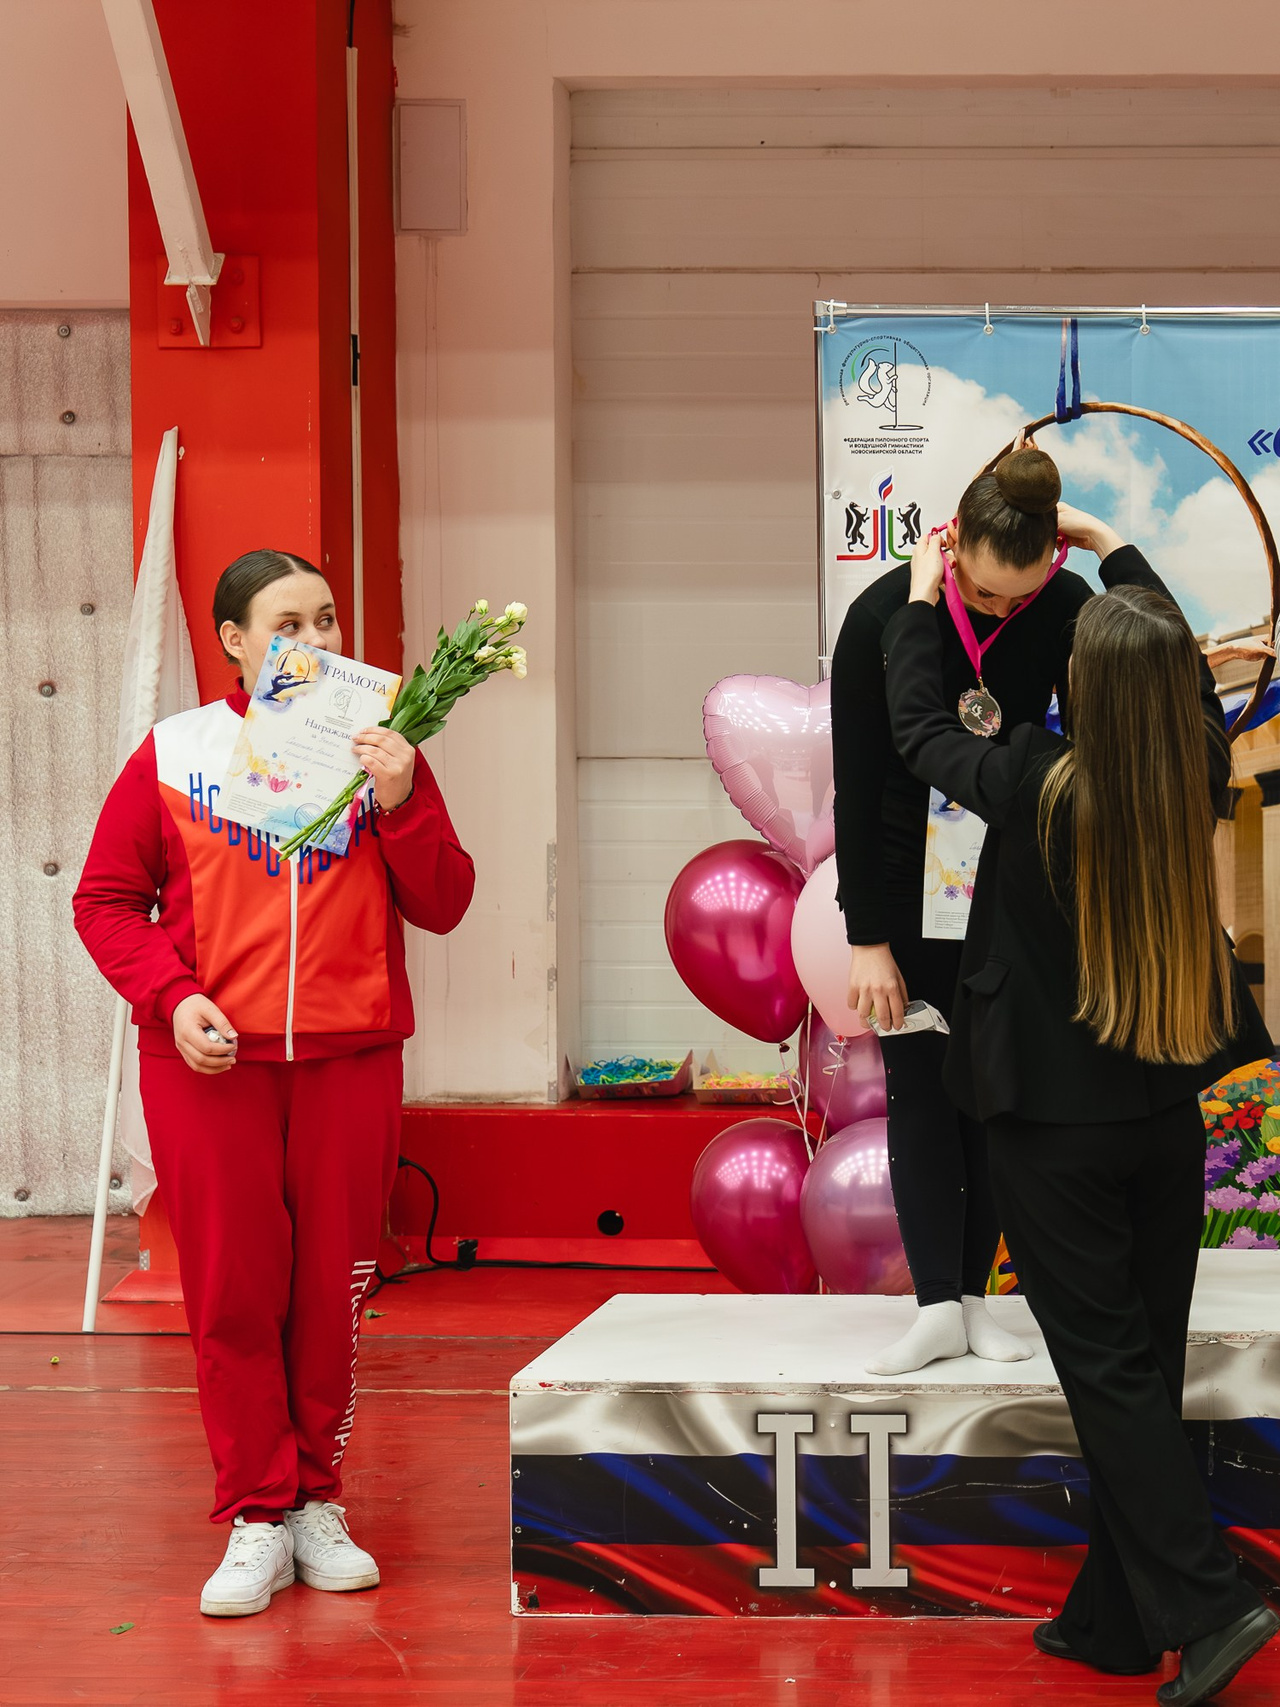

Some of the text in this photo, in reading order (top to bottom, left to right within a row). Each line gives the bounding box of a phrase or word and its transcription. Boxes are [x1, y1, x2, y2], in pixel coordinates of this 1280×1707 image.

[324, 664, 389, 696] ГРАМОТА
[304, 717, 353, 741] Награждае
[757, 1413, 909, 1588] II
